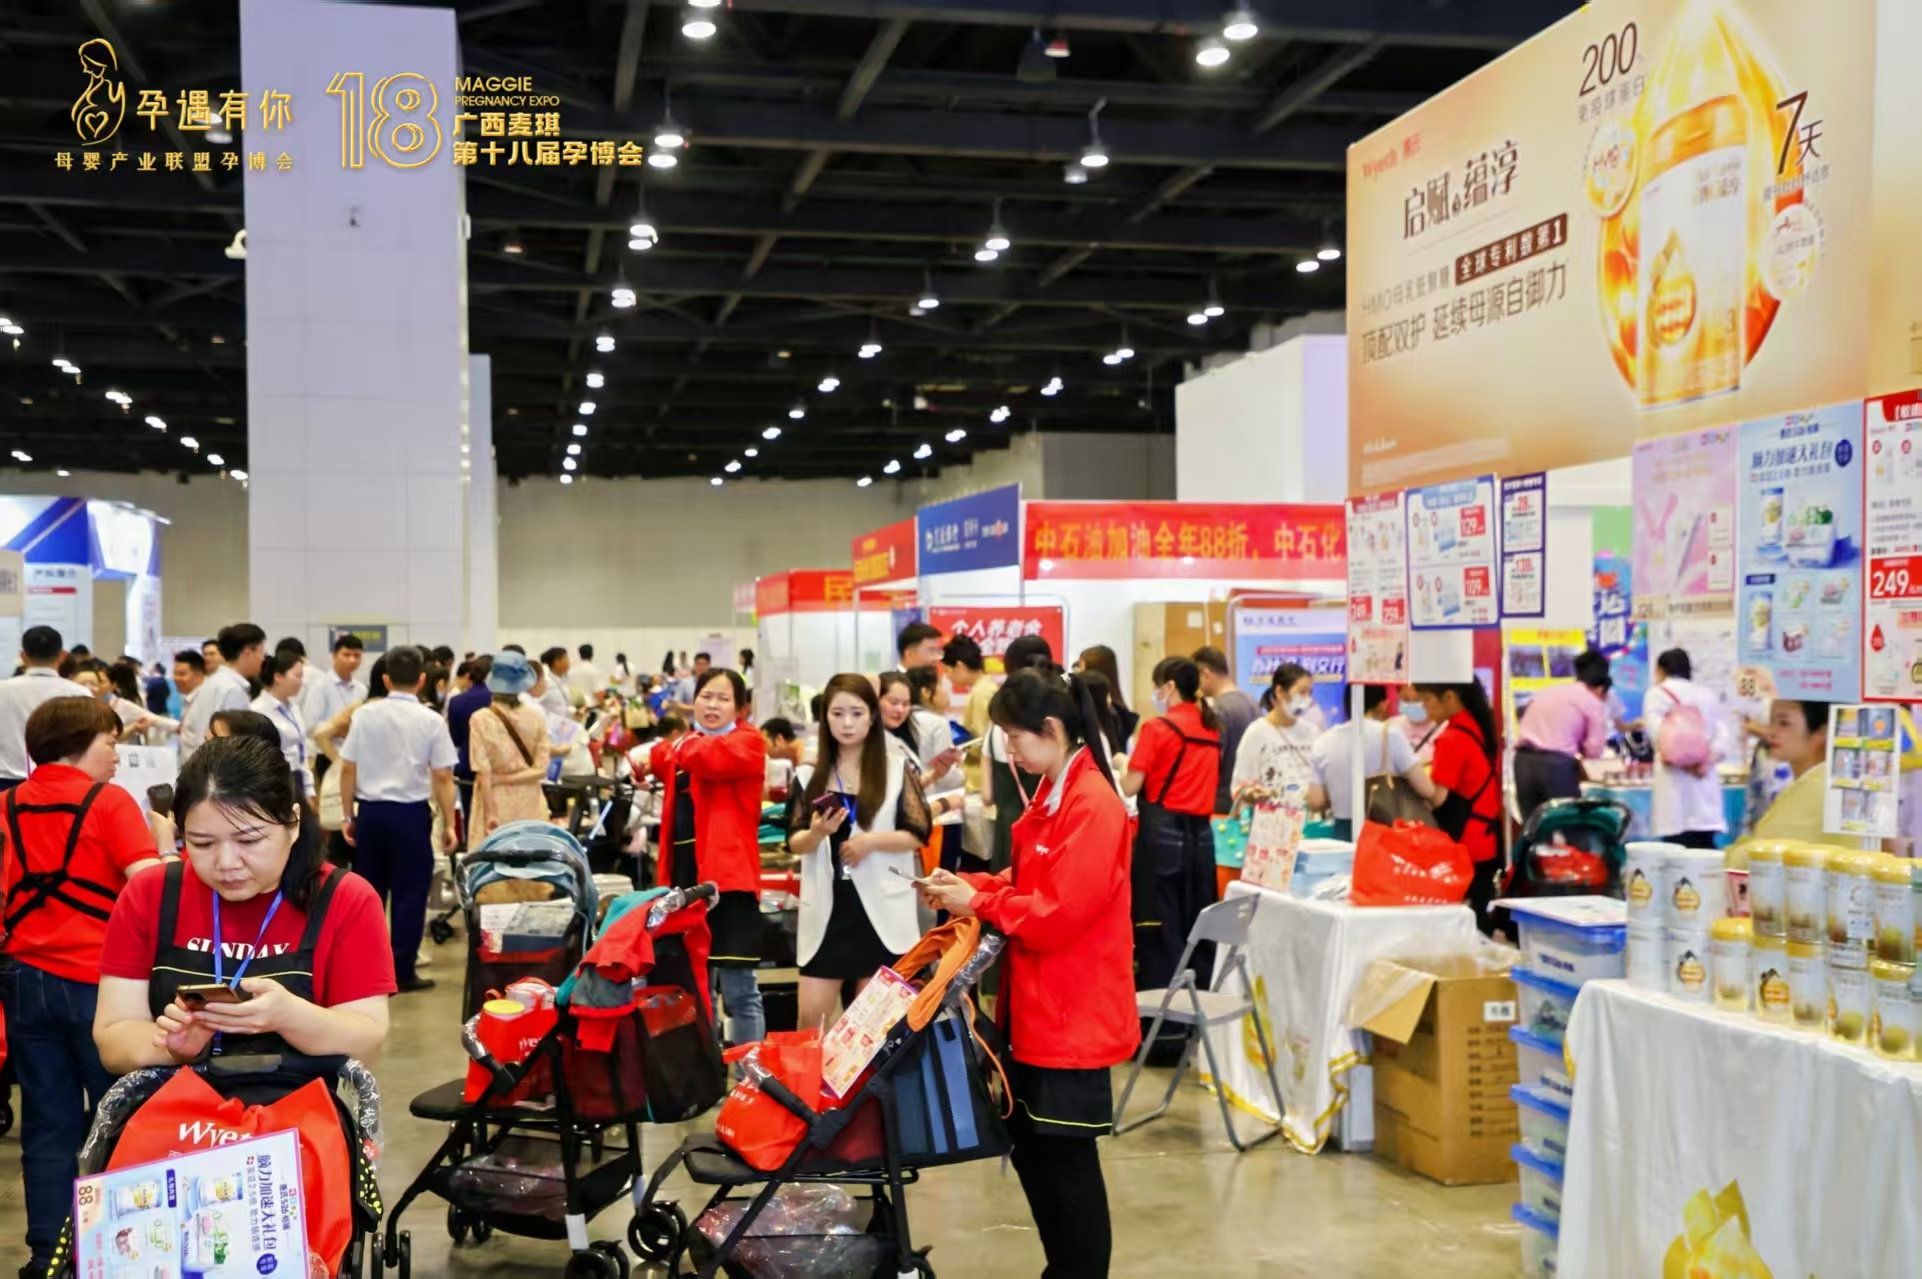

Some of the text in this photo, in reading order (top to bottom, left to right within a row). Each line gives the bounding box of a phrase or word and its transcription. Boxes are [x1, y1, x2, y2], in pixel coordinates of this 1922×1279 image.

[1579, 22, 1638, 97] 200
[1872, 570, 1910, 598] 249
[78, 1185, 93, 1206] 88
[257, 1153, 277, 1250] 脑力加速大礼包
